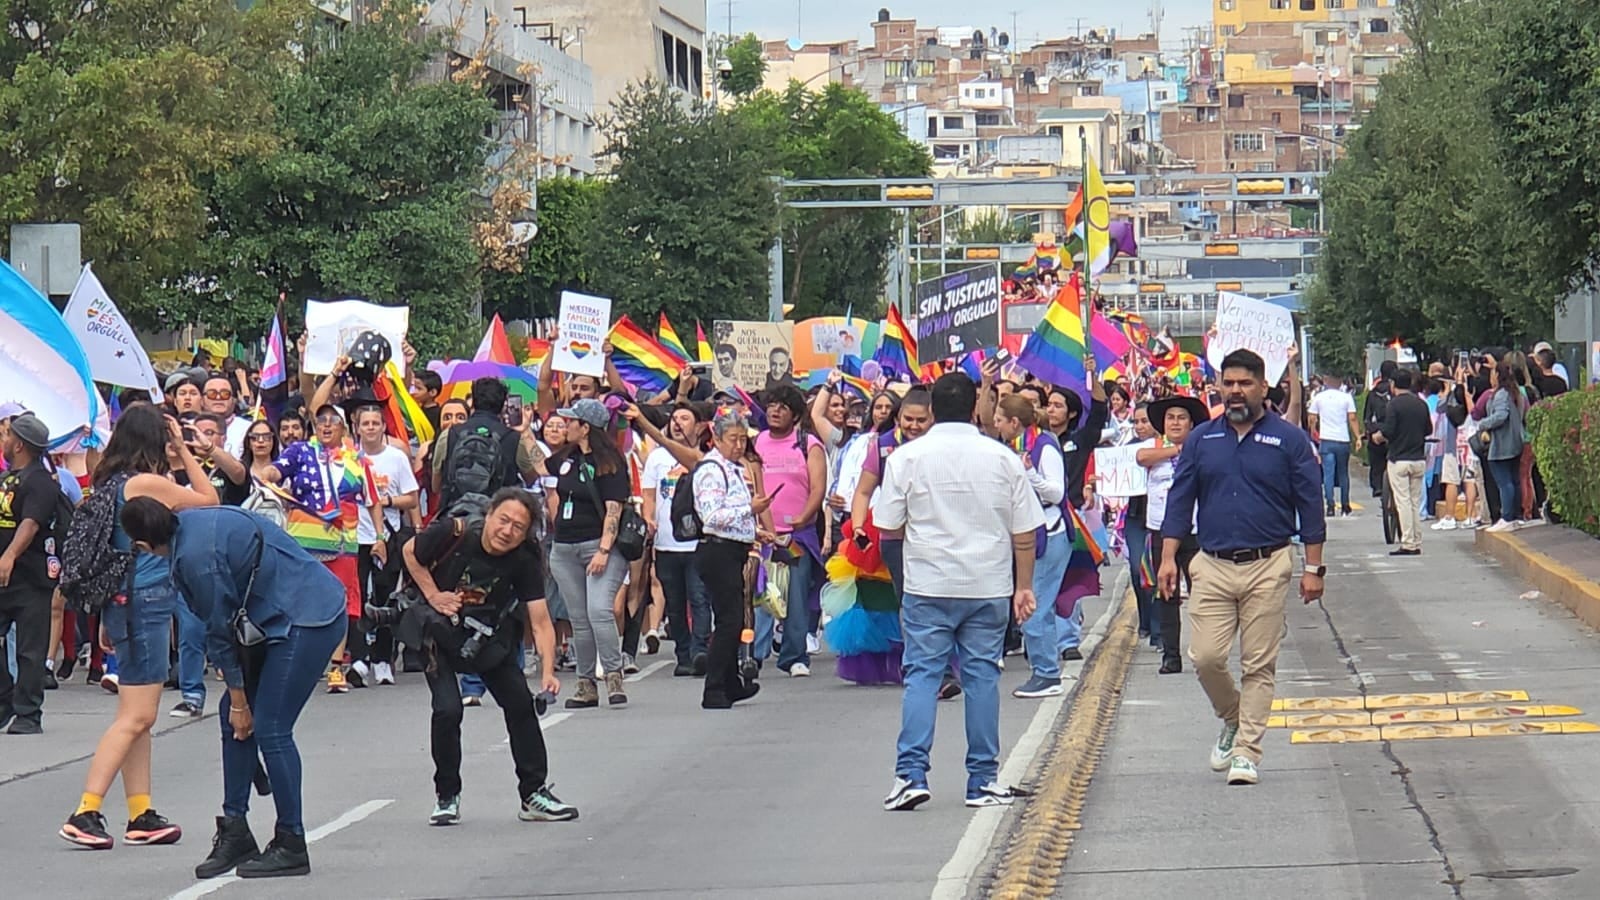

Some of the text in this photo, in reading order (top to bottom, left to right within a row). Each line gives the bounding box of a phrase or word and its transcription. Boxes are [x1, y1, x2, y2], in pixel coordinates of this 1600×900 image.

[919, 293, 942, 319] SIN
[944, 276, 997, 312] JUSTICIA
[90, 298, 107, 311] MI
[569, 304, 600, 316] NUESTRAS
[1221, 294, 1272, 324] Venimos
[98, 313, 113, 326] ES
[567, 313, 601, 326] FAMILIAS
[919, 298, 998, 340] NO HAY ORGULLO
[568, 322, 597, 333] EXISTEN
[741, 328, 757, 336] NOS
[569, 331, 600, 343] RESISTEN
